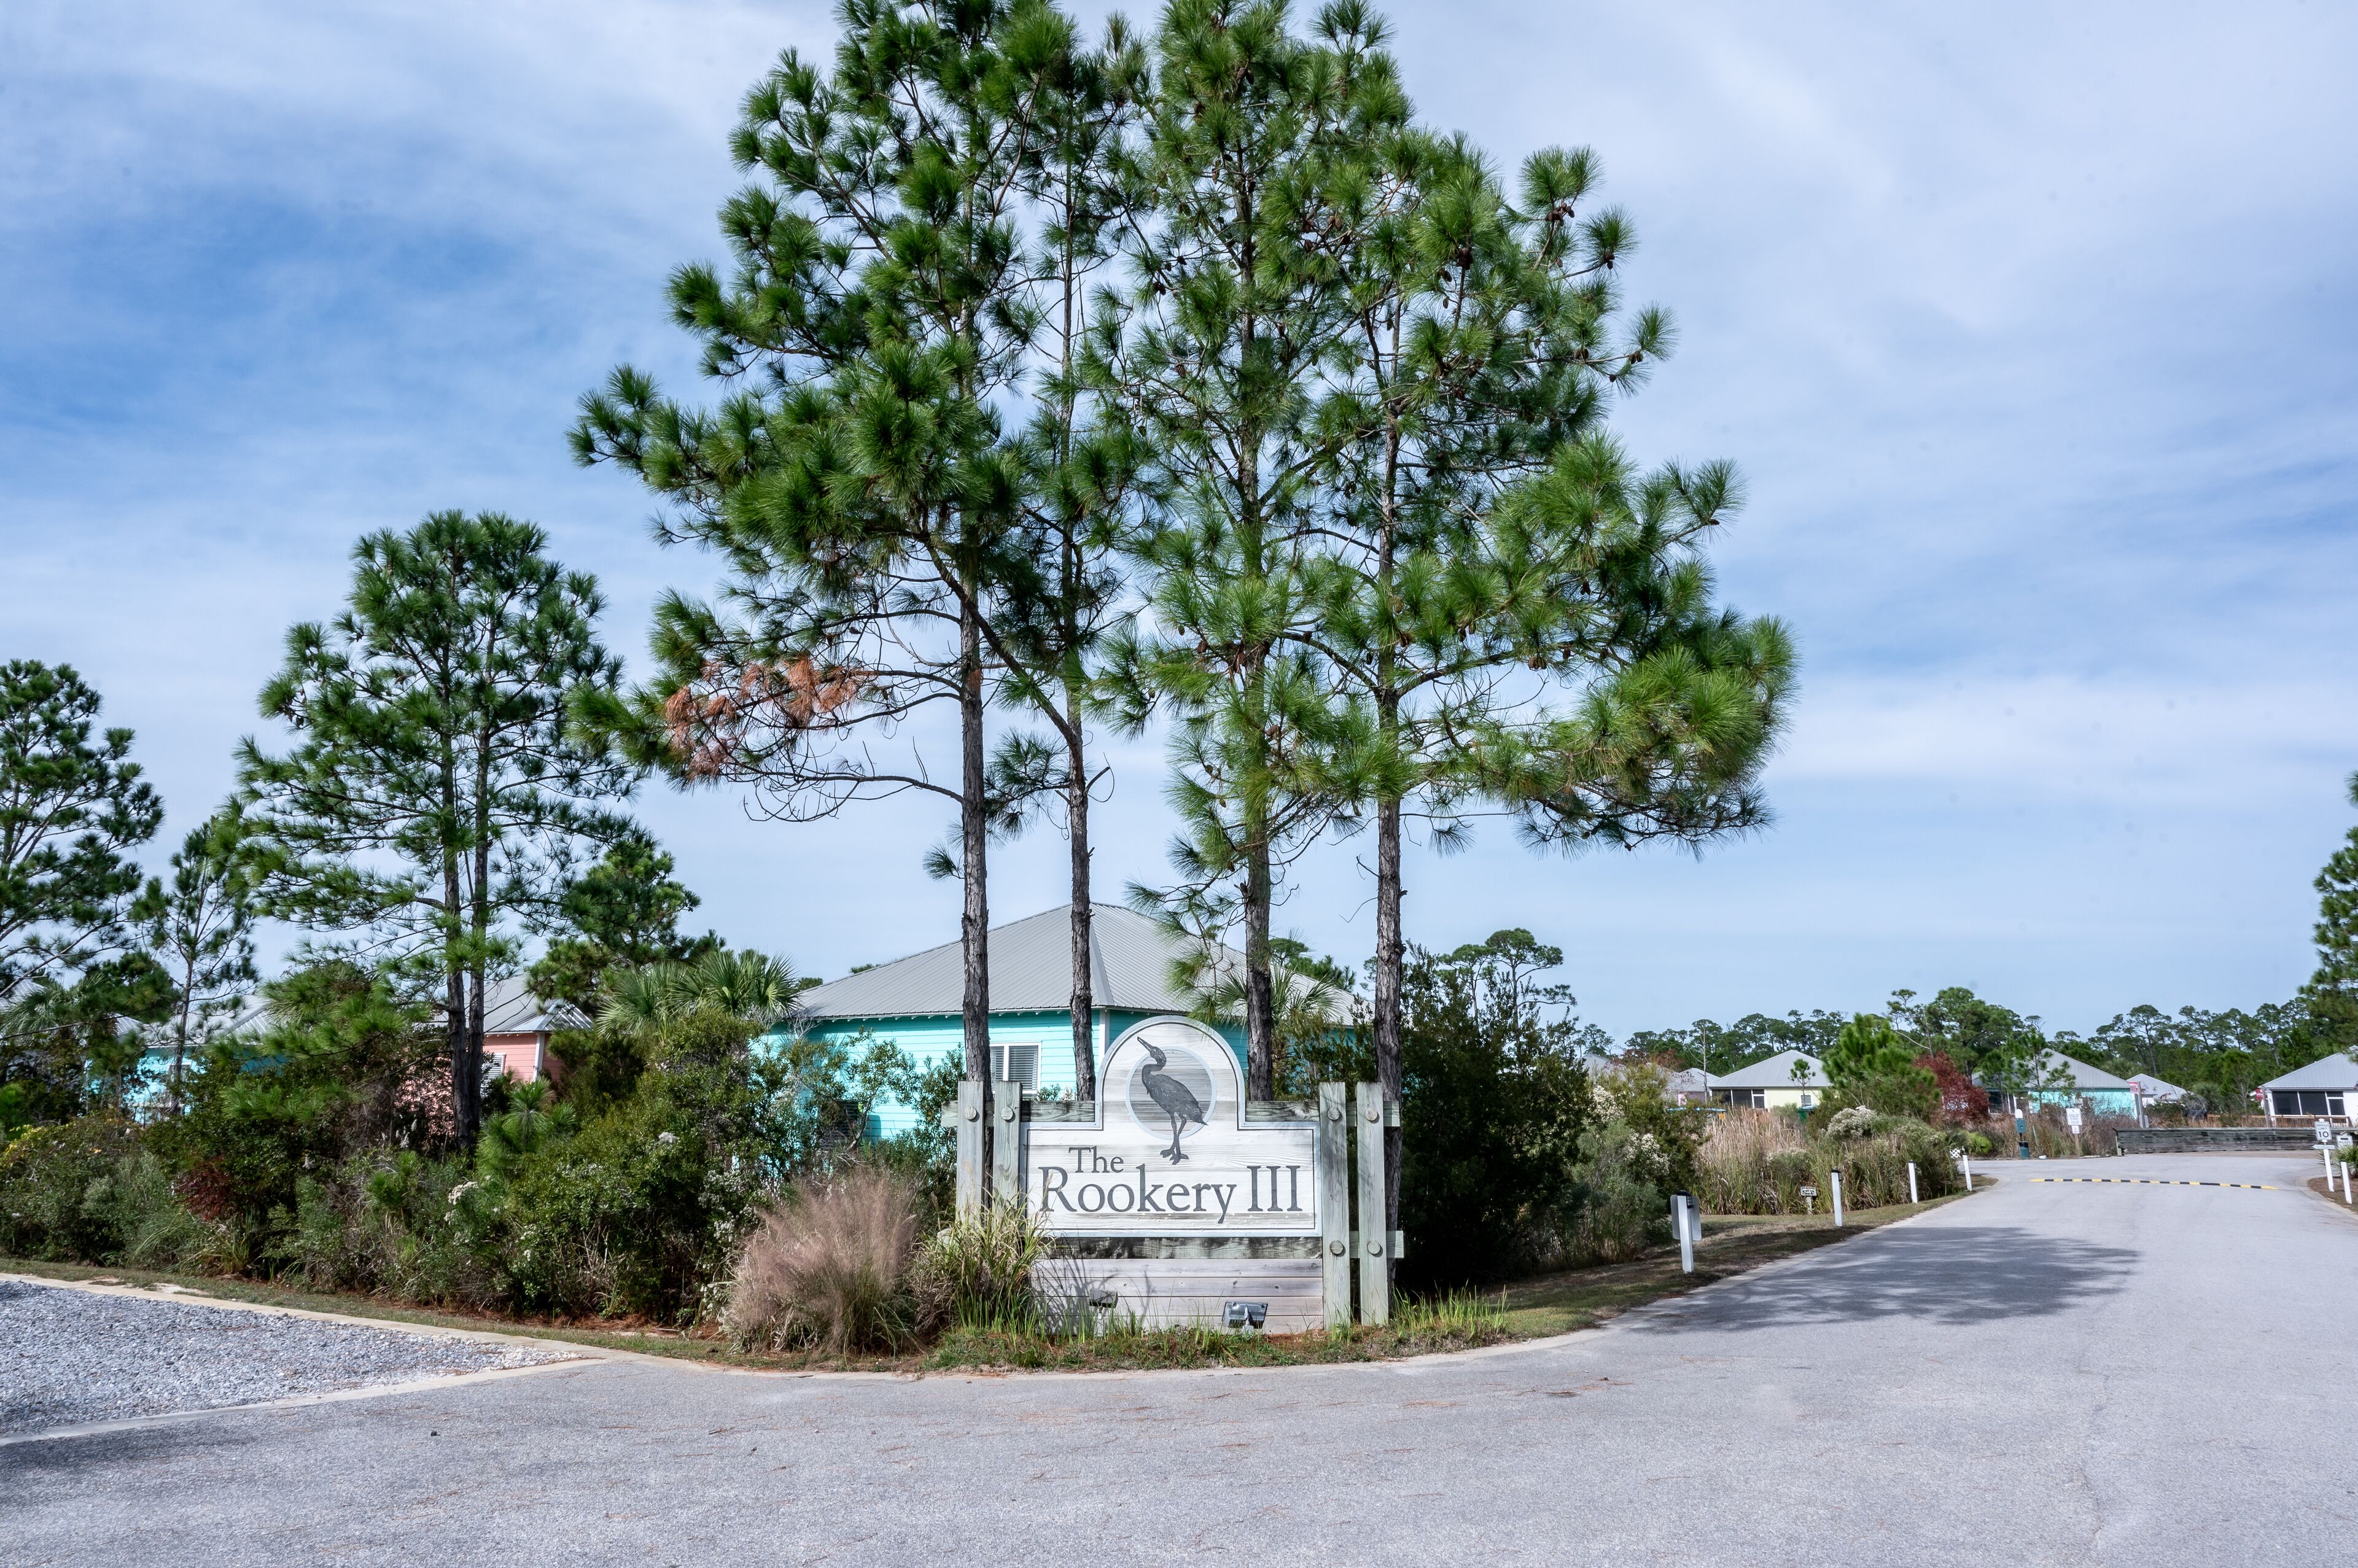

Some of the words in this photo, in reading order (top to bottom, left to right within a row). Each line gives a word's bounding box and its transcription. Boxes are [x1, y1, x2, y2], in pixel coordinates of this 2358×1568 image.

[1068, 1146, 1124, 1173] The
[1038, 1163, 1237, 1224] Rookery
[1247, 1165, 1303, 1212] III
